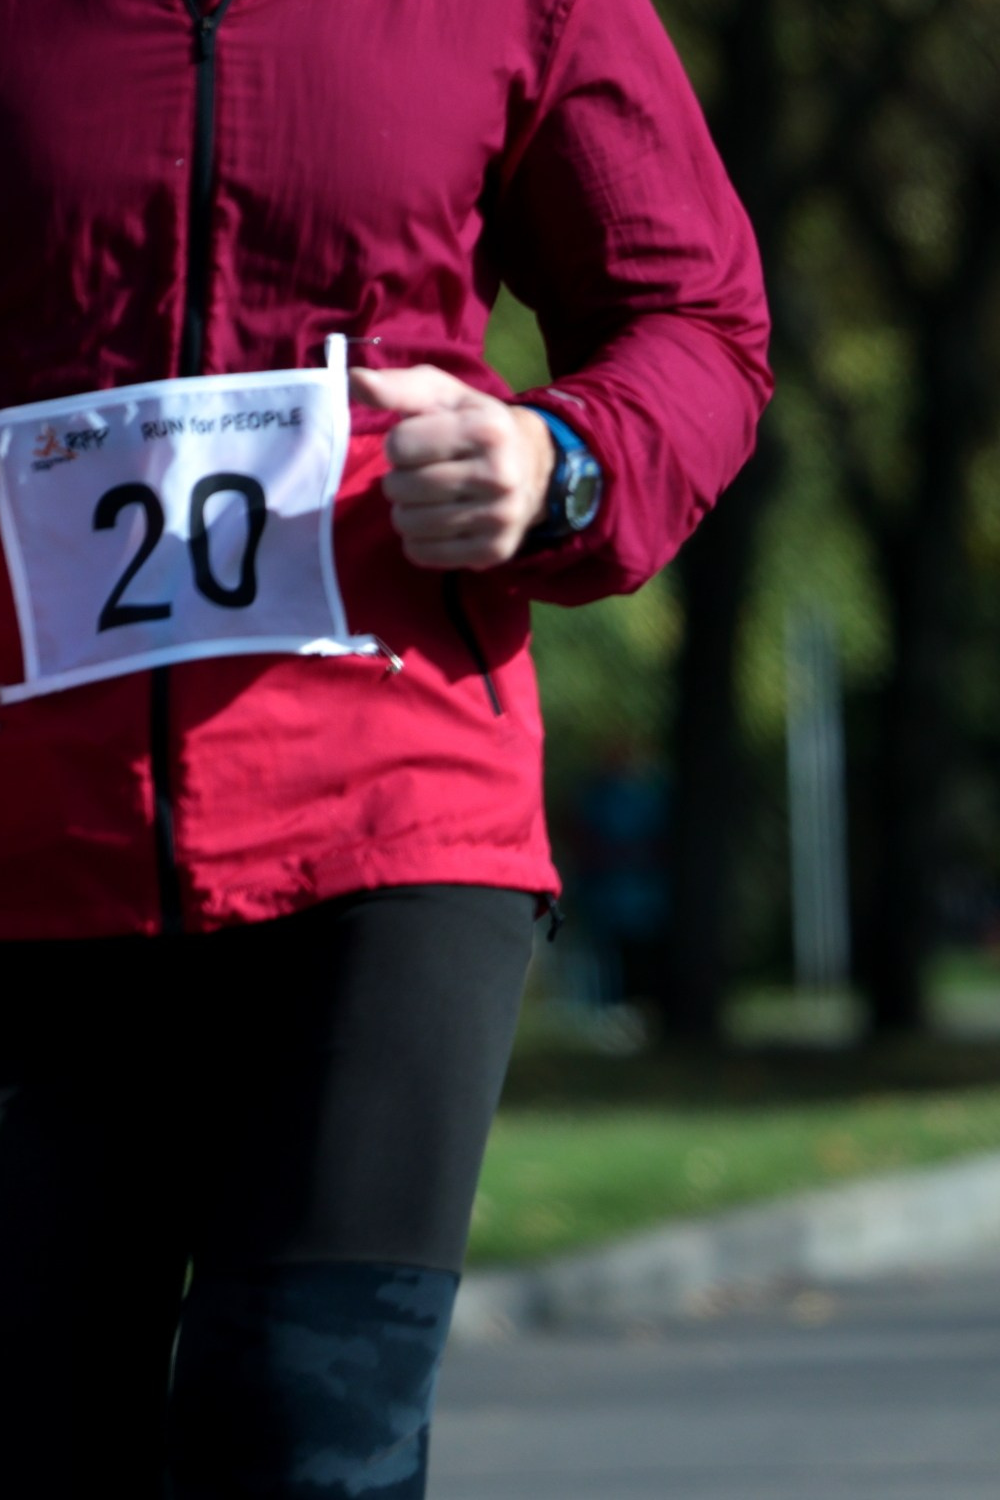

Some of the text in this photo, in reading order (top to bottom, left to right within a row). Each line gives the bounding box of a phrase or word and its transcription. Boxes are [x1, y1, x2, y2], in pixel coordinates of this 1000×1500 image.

[141, 407, 302, 441] RUN for PEOPLE
[93, 473, 267, 633] 20
